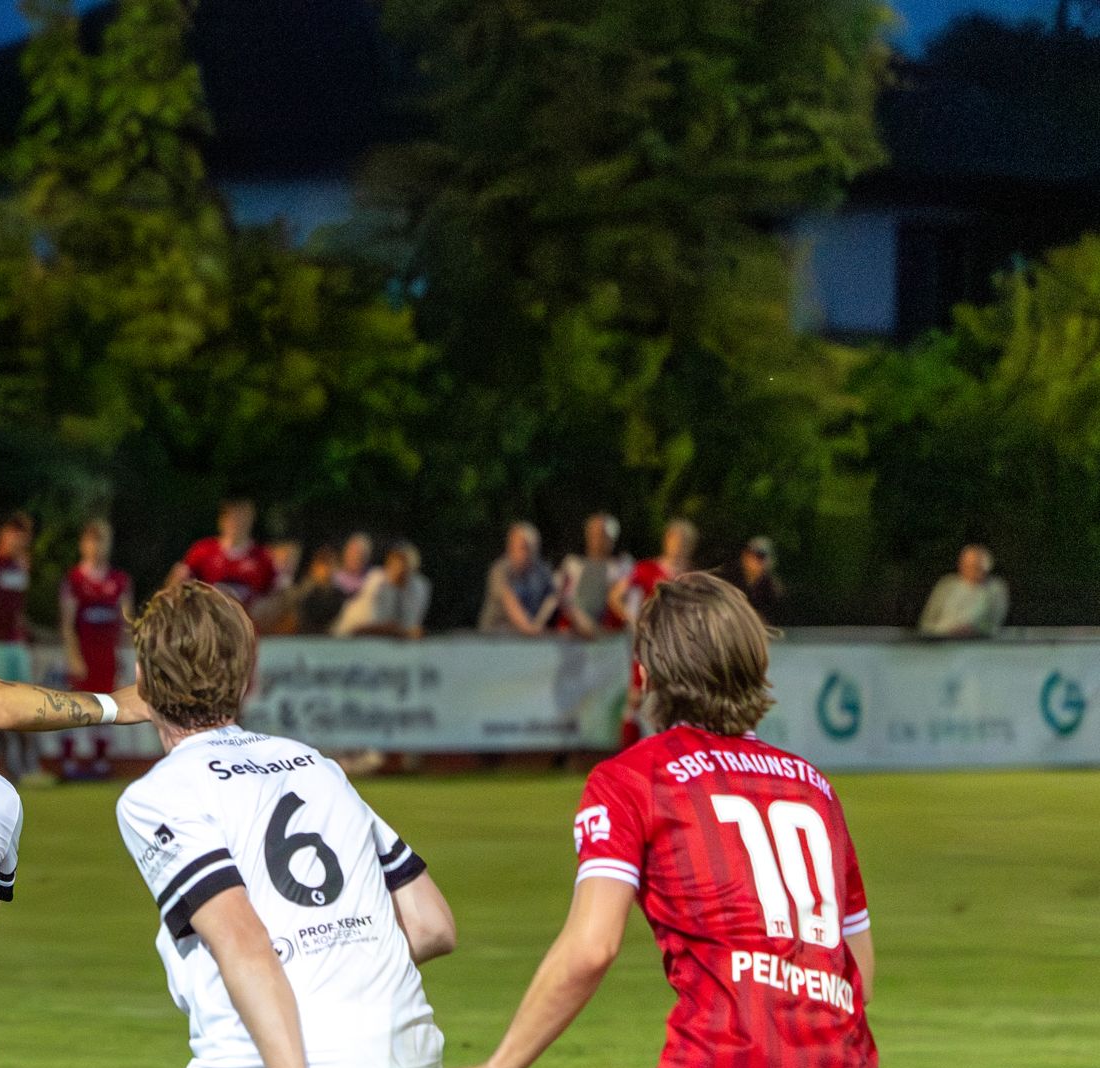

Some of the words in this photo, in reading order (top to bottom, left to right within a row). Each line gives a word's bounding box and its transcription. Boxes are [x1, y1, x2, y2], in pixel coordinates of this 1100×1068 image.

[208, 754, 316, 780] Seebauer
[665, 750, 716, 783] SBC
[709, 749, 834, 801] TRAUNSTEIN
[264, 791, 345, 908] 6
[709, 794, 841, 949] 10
[731, 950, 855, 1015] PELYPENKO
